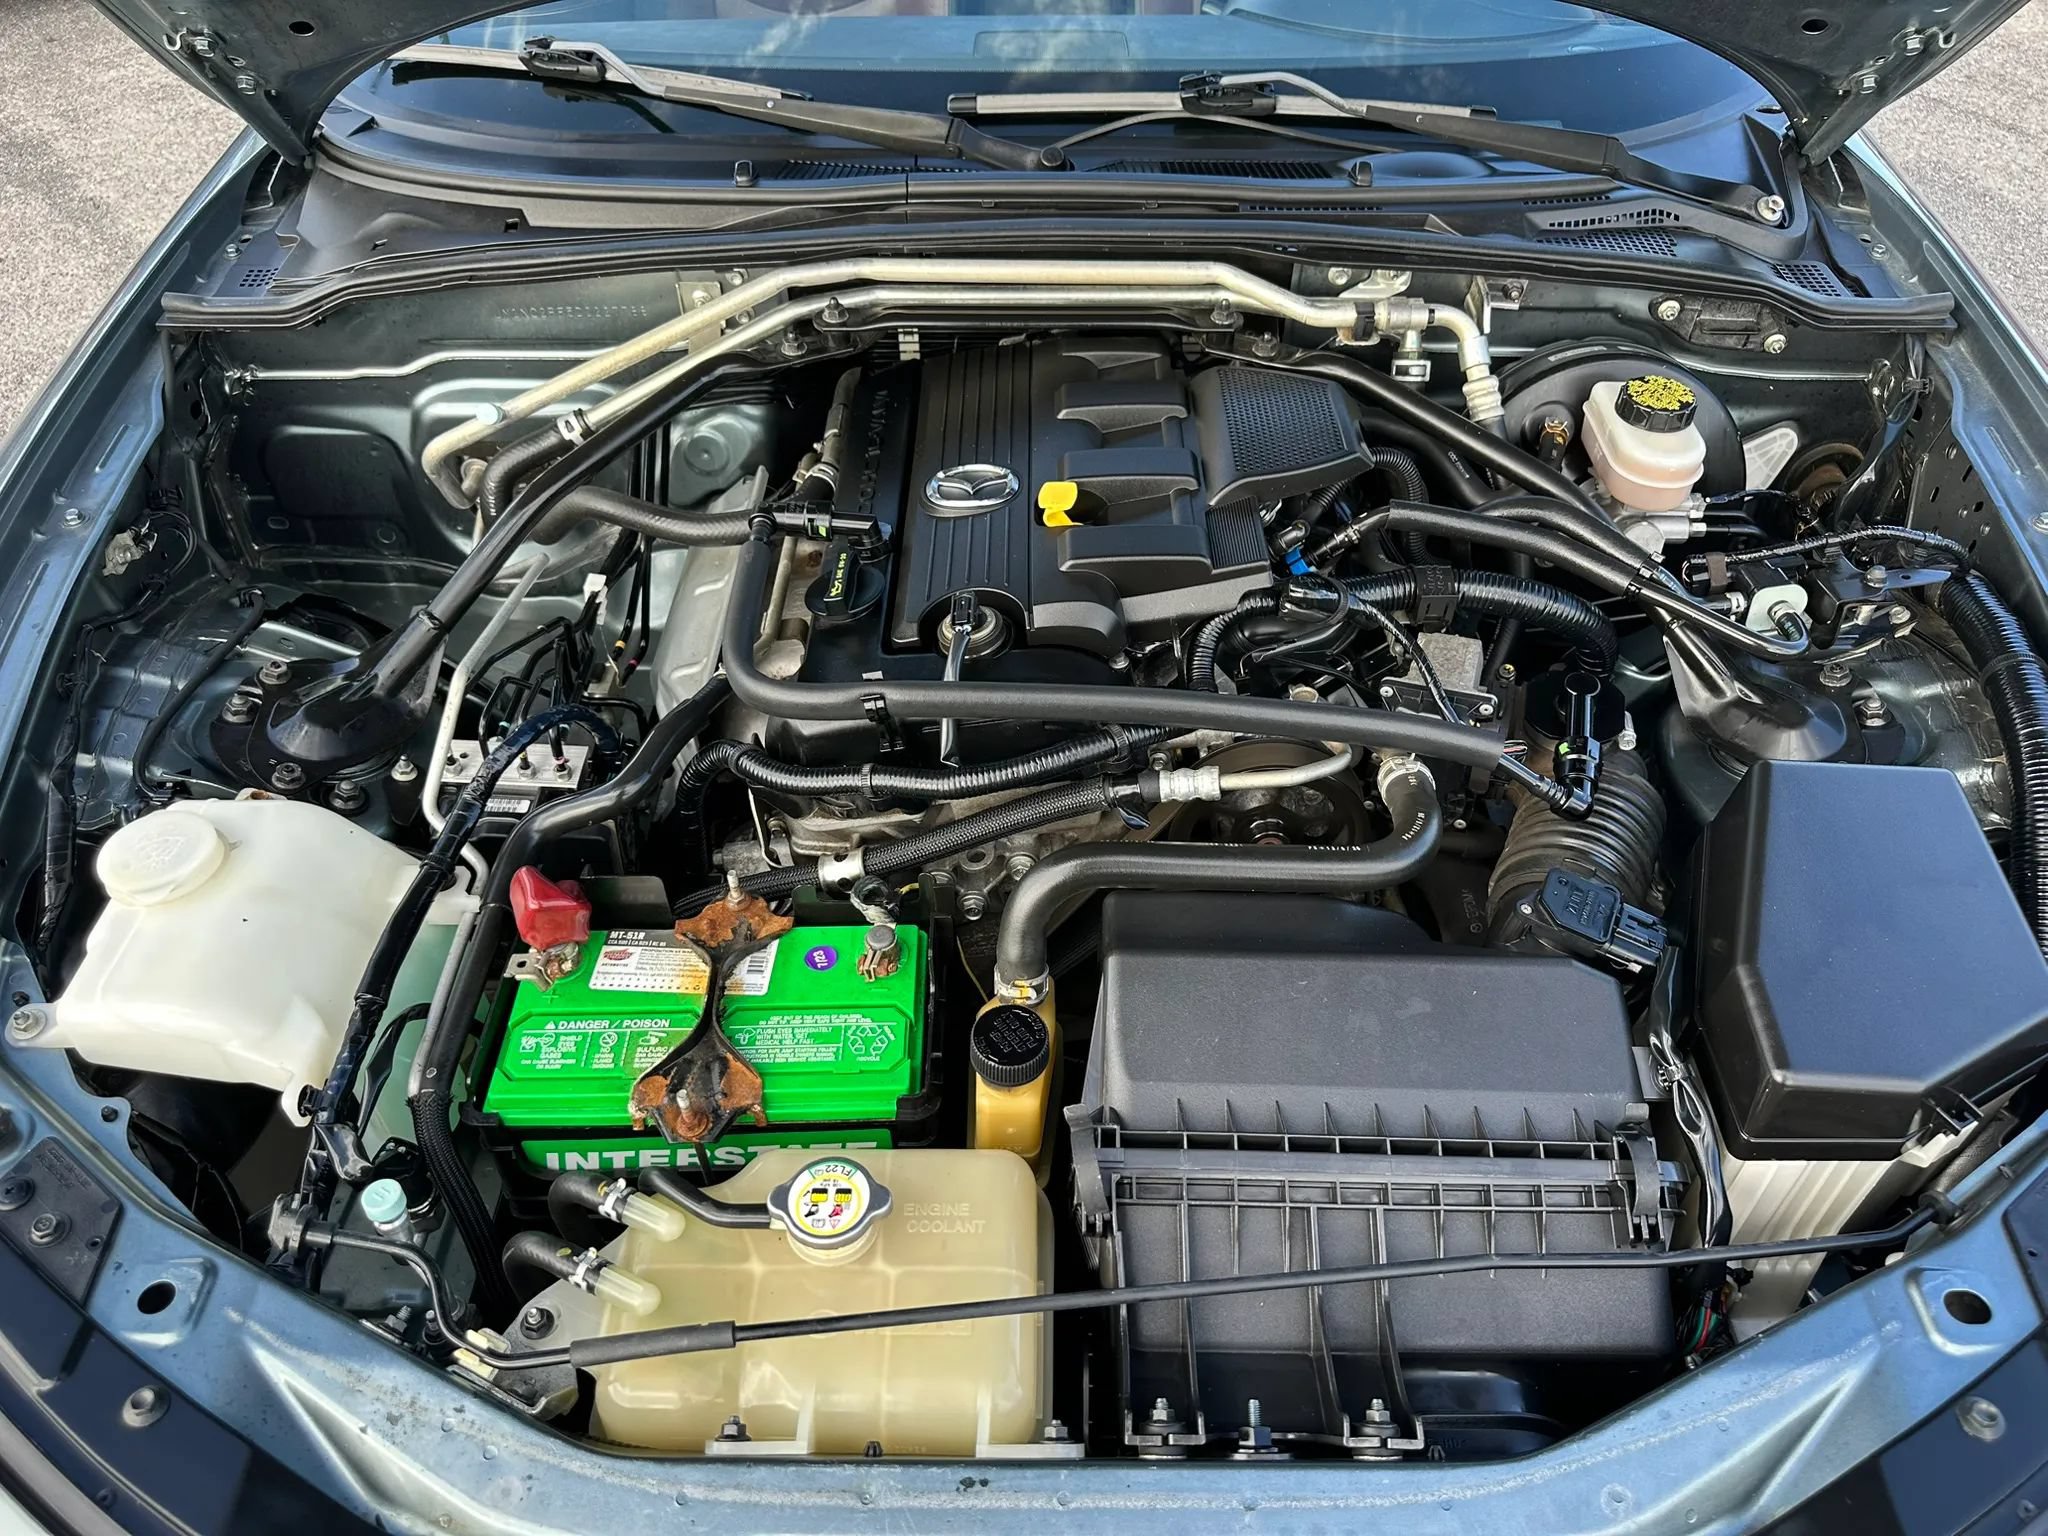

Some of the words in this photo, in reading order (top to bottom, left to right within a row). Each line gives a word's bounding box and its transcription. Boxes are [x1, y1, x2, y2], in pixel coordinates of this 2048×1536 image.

[558, 1020, 610, 1029] DANGER
[622, 1019, 670, 1028] POISON
[824, 1164, 853, 1177] FL22
[904, 1203, 970, 1216] ENGINE
[906, 1220, 986, 1233] COOLANT
